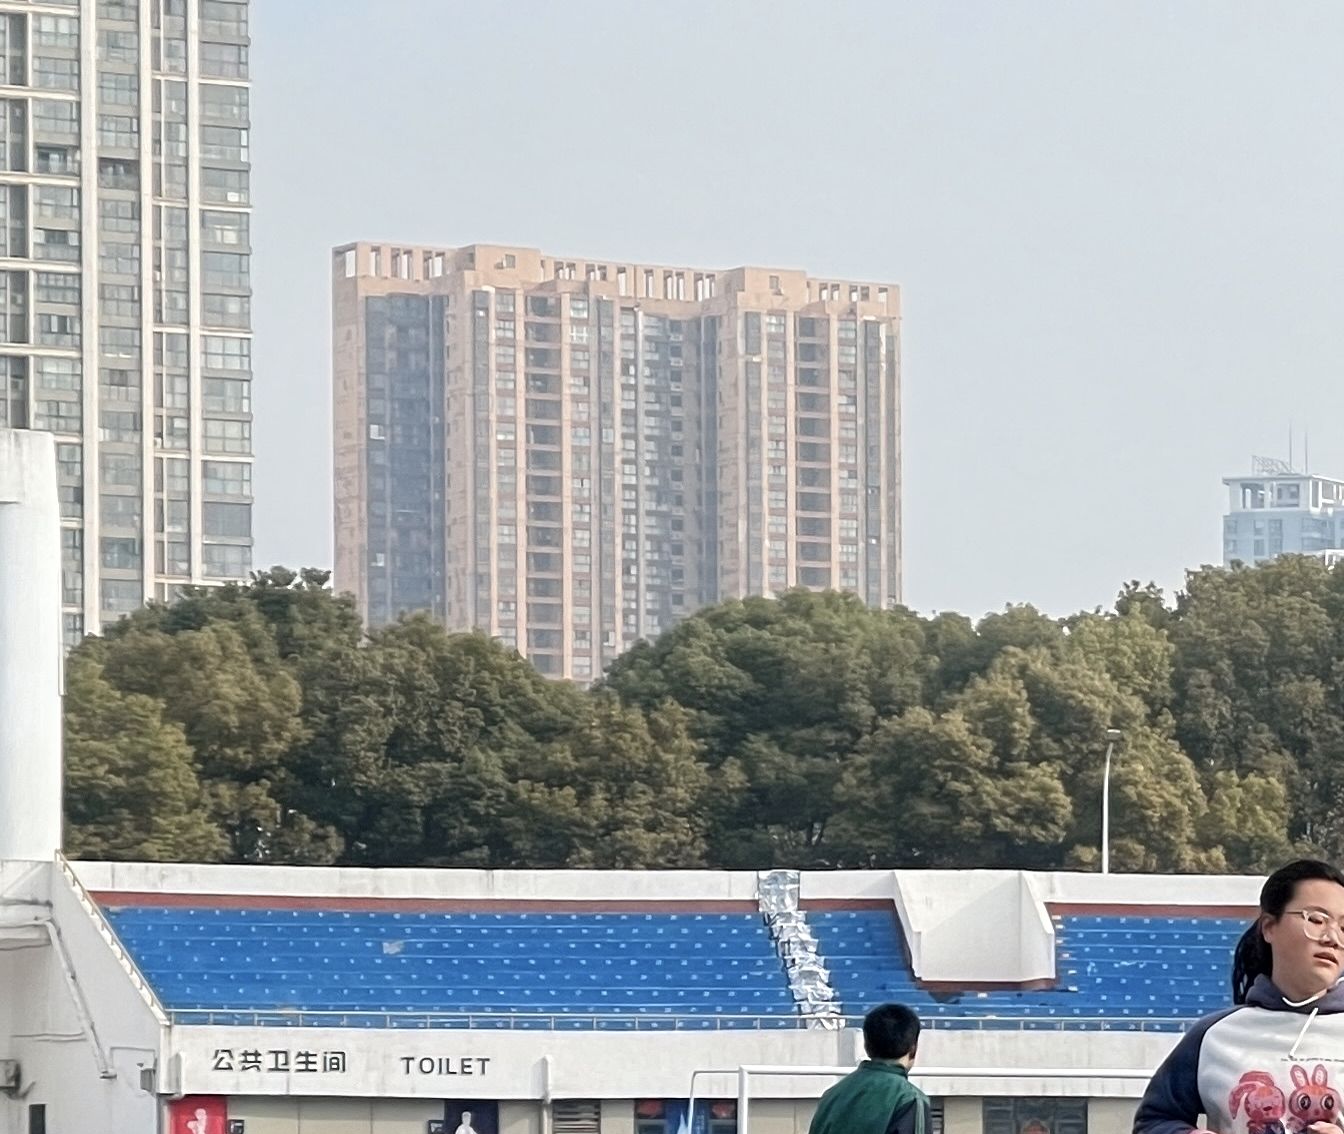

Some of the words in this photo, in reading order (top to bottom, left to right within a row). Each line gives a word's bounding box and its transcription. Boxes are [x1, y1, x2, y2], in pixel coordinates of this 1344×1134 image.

[212, 1049, 346, 1073] 公共卫生间
[401, 1057, 490, 1075] TOILET
